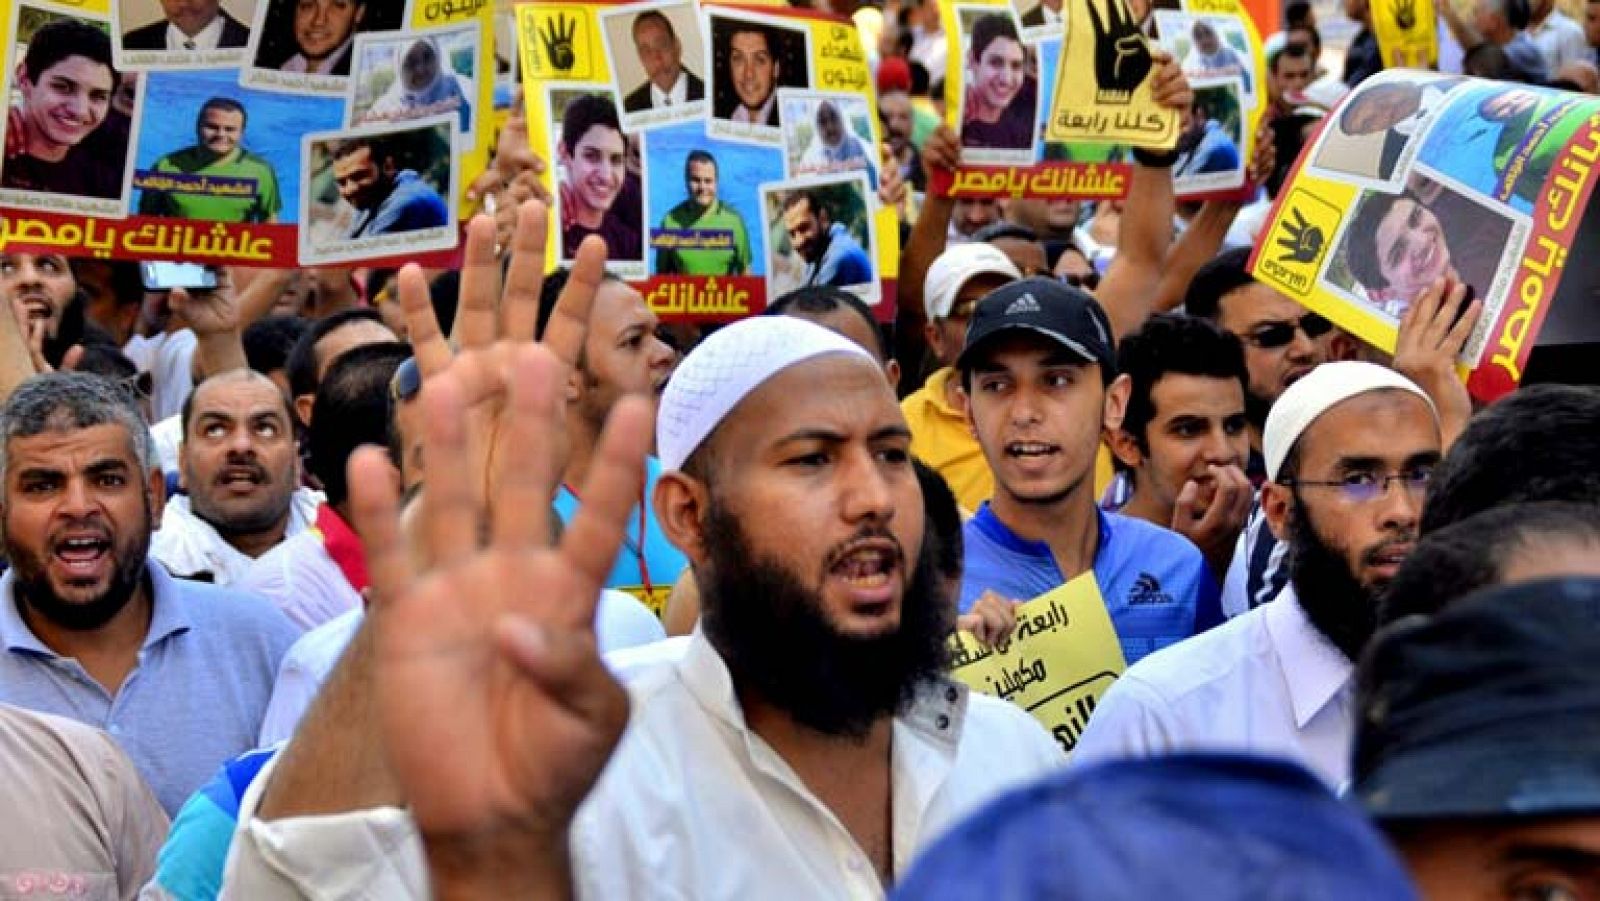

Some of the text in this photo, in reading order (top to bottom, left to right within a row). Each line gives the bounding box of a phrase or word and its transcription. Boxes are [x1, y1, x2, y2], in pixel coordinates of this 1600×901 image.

[1057, 109, 1165, 133] كلنا رابعة
[1031, 168, 1123, 195] علشانك
[123, 221, 272, 260] علشانك
[647, 277, 749, 314] علشانك
[1018, 600, 1069, 641] رابعة
